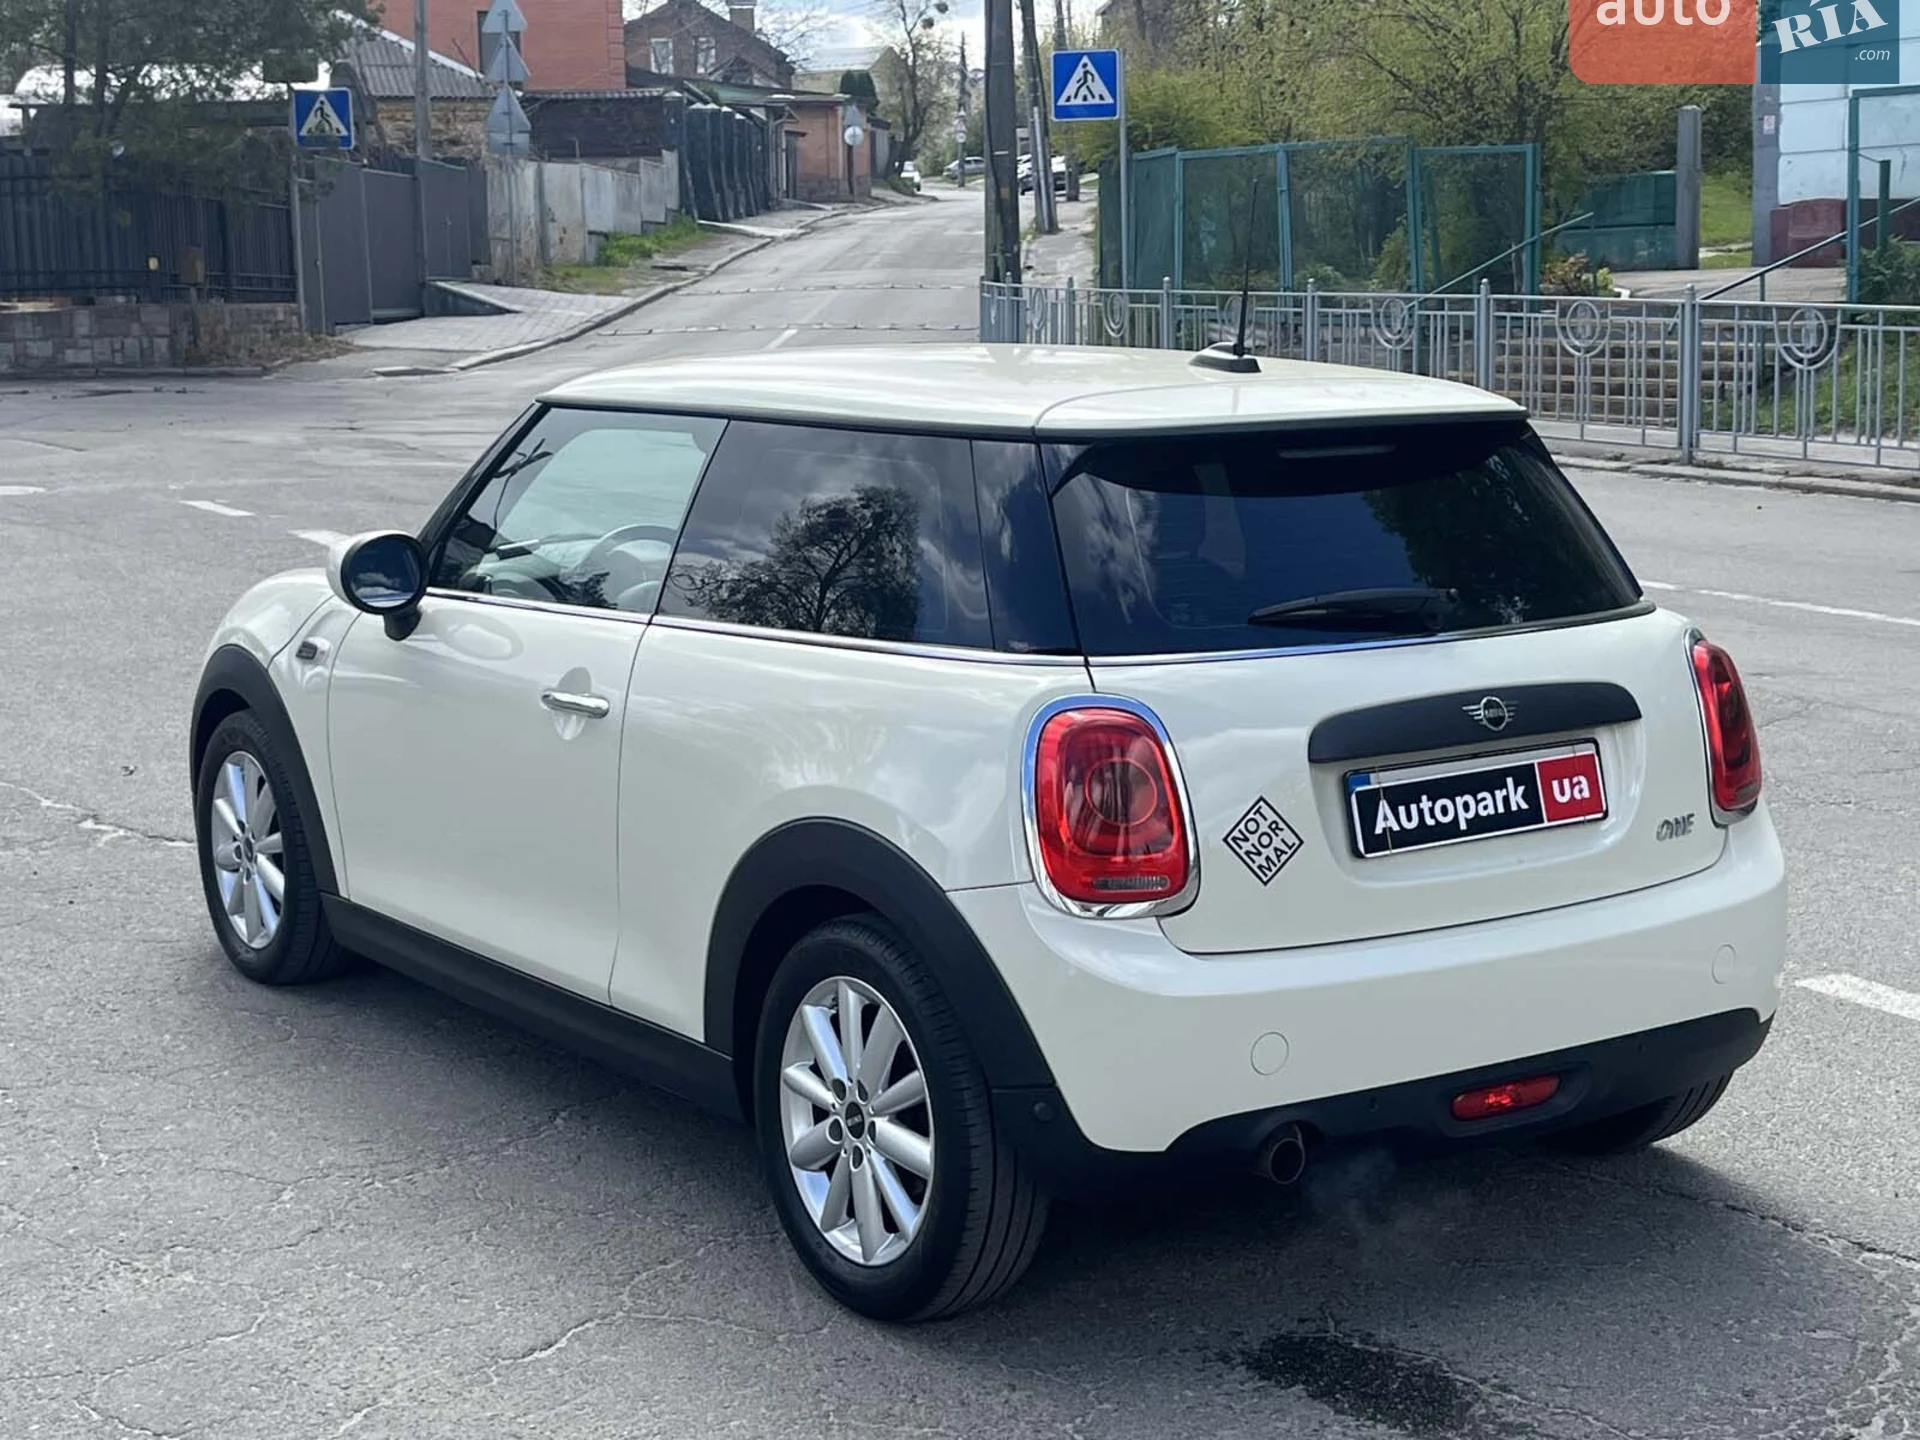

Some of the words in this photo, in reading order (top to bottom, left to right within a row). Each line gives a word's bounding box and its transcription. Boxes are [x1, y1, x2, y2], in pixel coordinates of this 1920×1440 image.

[1374, 777, 1530, 835] Autopark
[1551, 774, 1591, 804] ua
[1231, 806, 1268, 850] NOT
[1244, 820, 1285, 864] NOR
[1656, 812, 1695, 842] ONE
[1257, 838, 1296, 878] MAL
